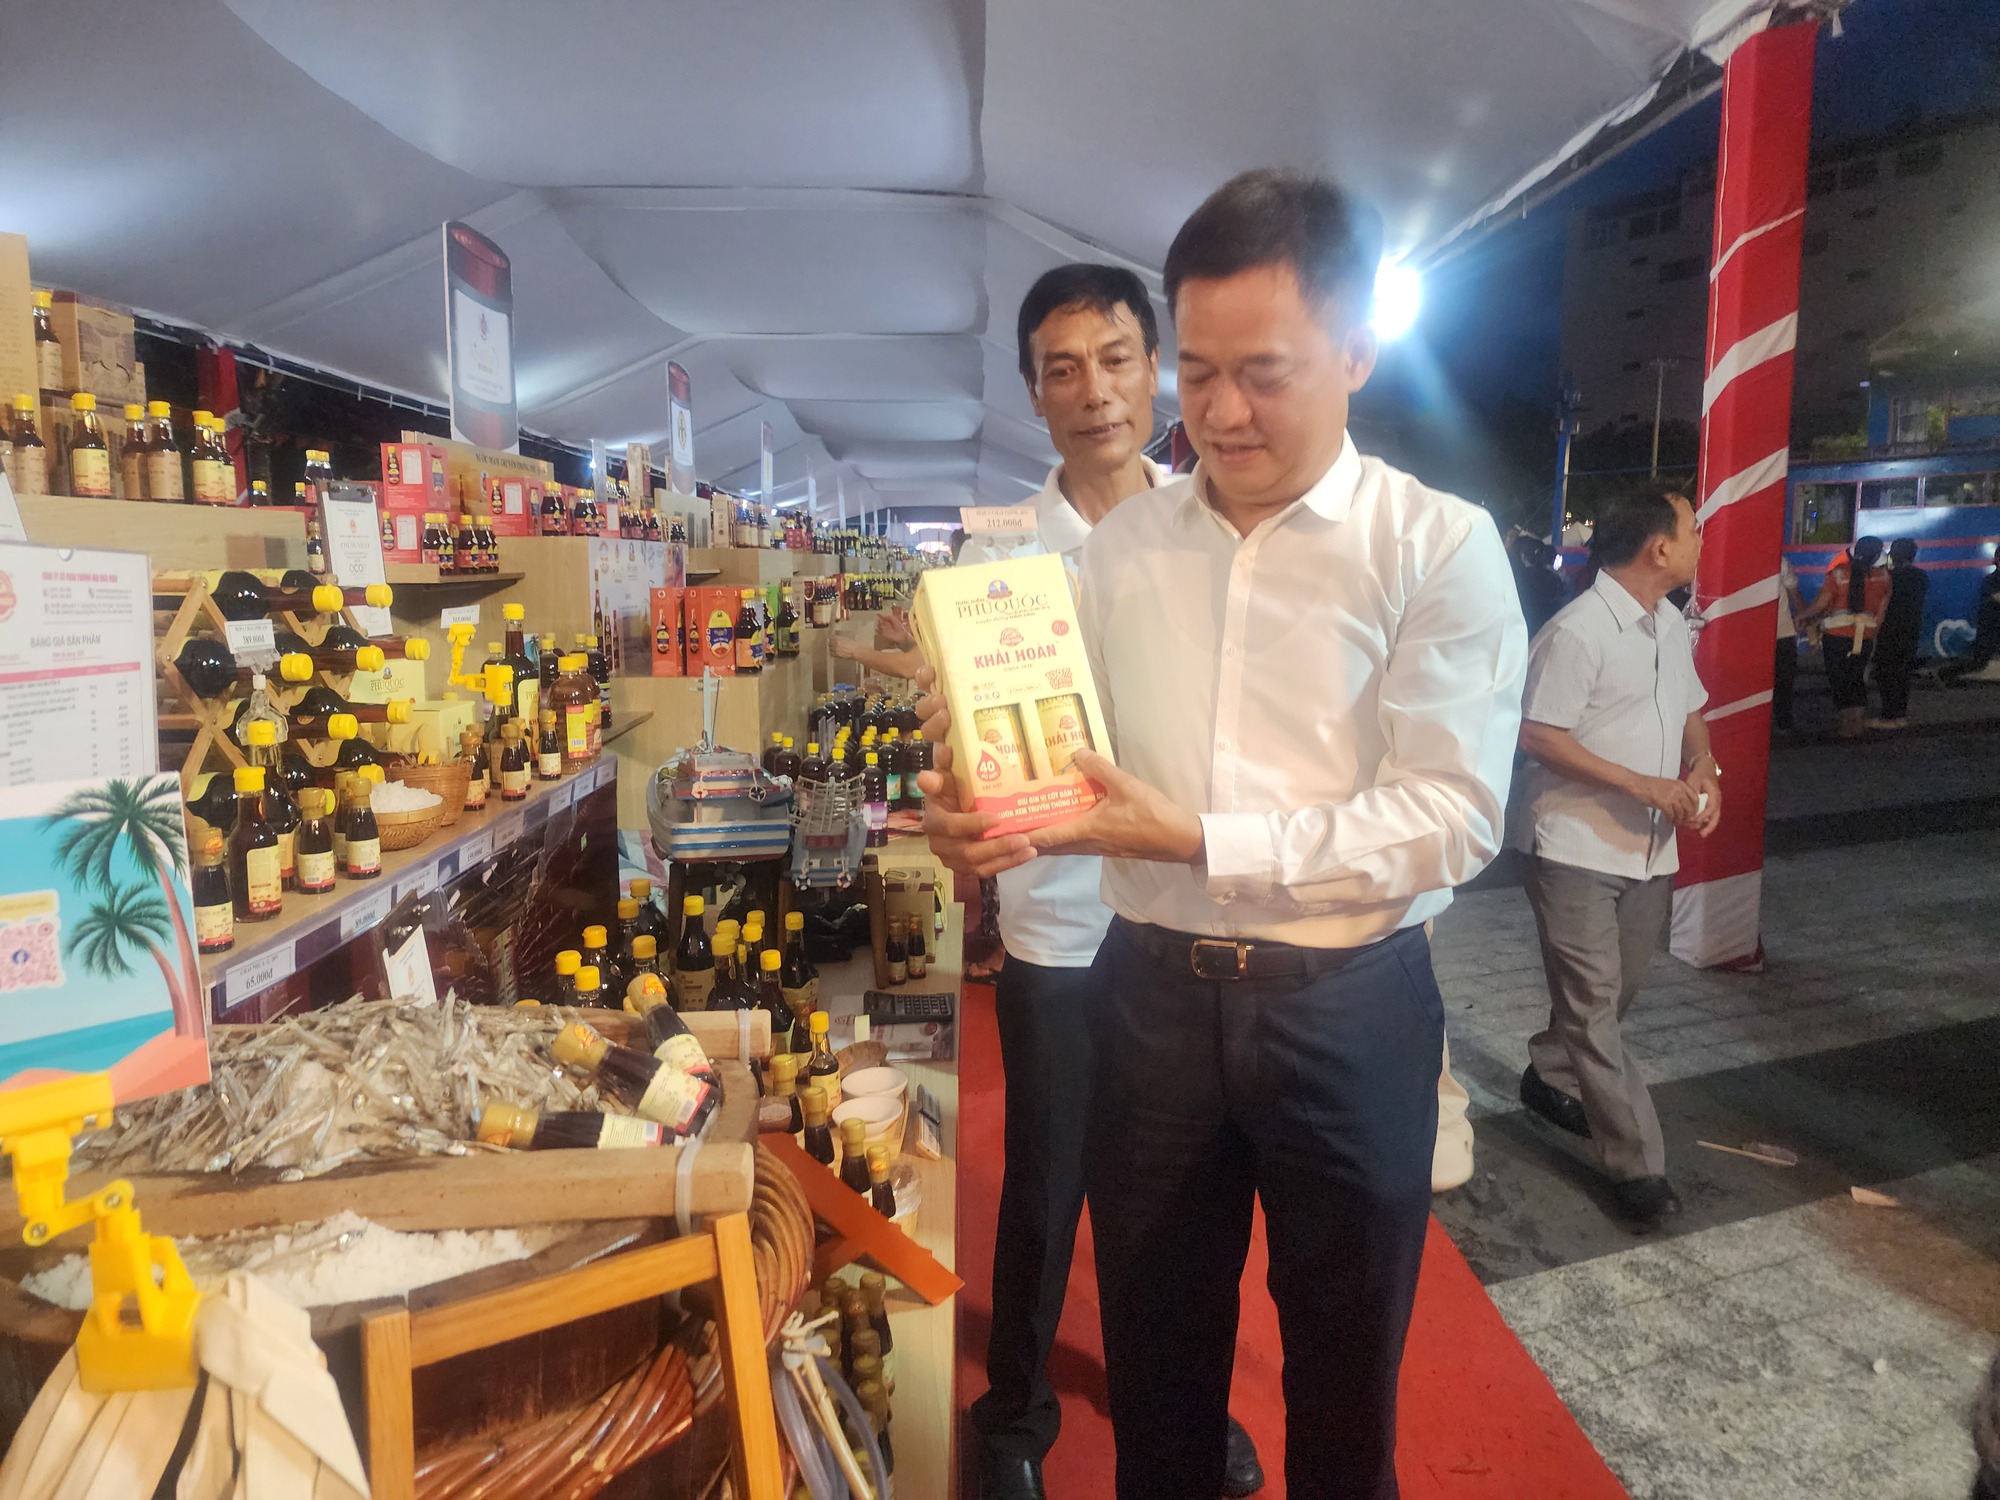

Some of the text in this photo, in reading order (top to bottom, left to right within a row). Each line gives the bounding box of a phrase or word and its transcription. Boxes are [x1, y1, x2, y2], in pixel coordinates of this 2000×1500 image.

[30, 633, 101, 648] BẢNG GIÁ SẢN PHẨM
[974, 643, 1056, 668] KHẢI HOÀN
[980, 760, 995, 773] 40
